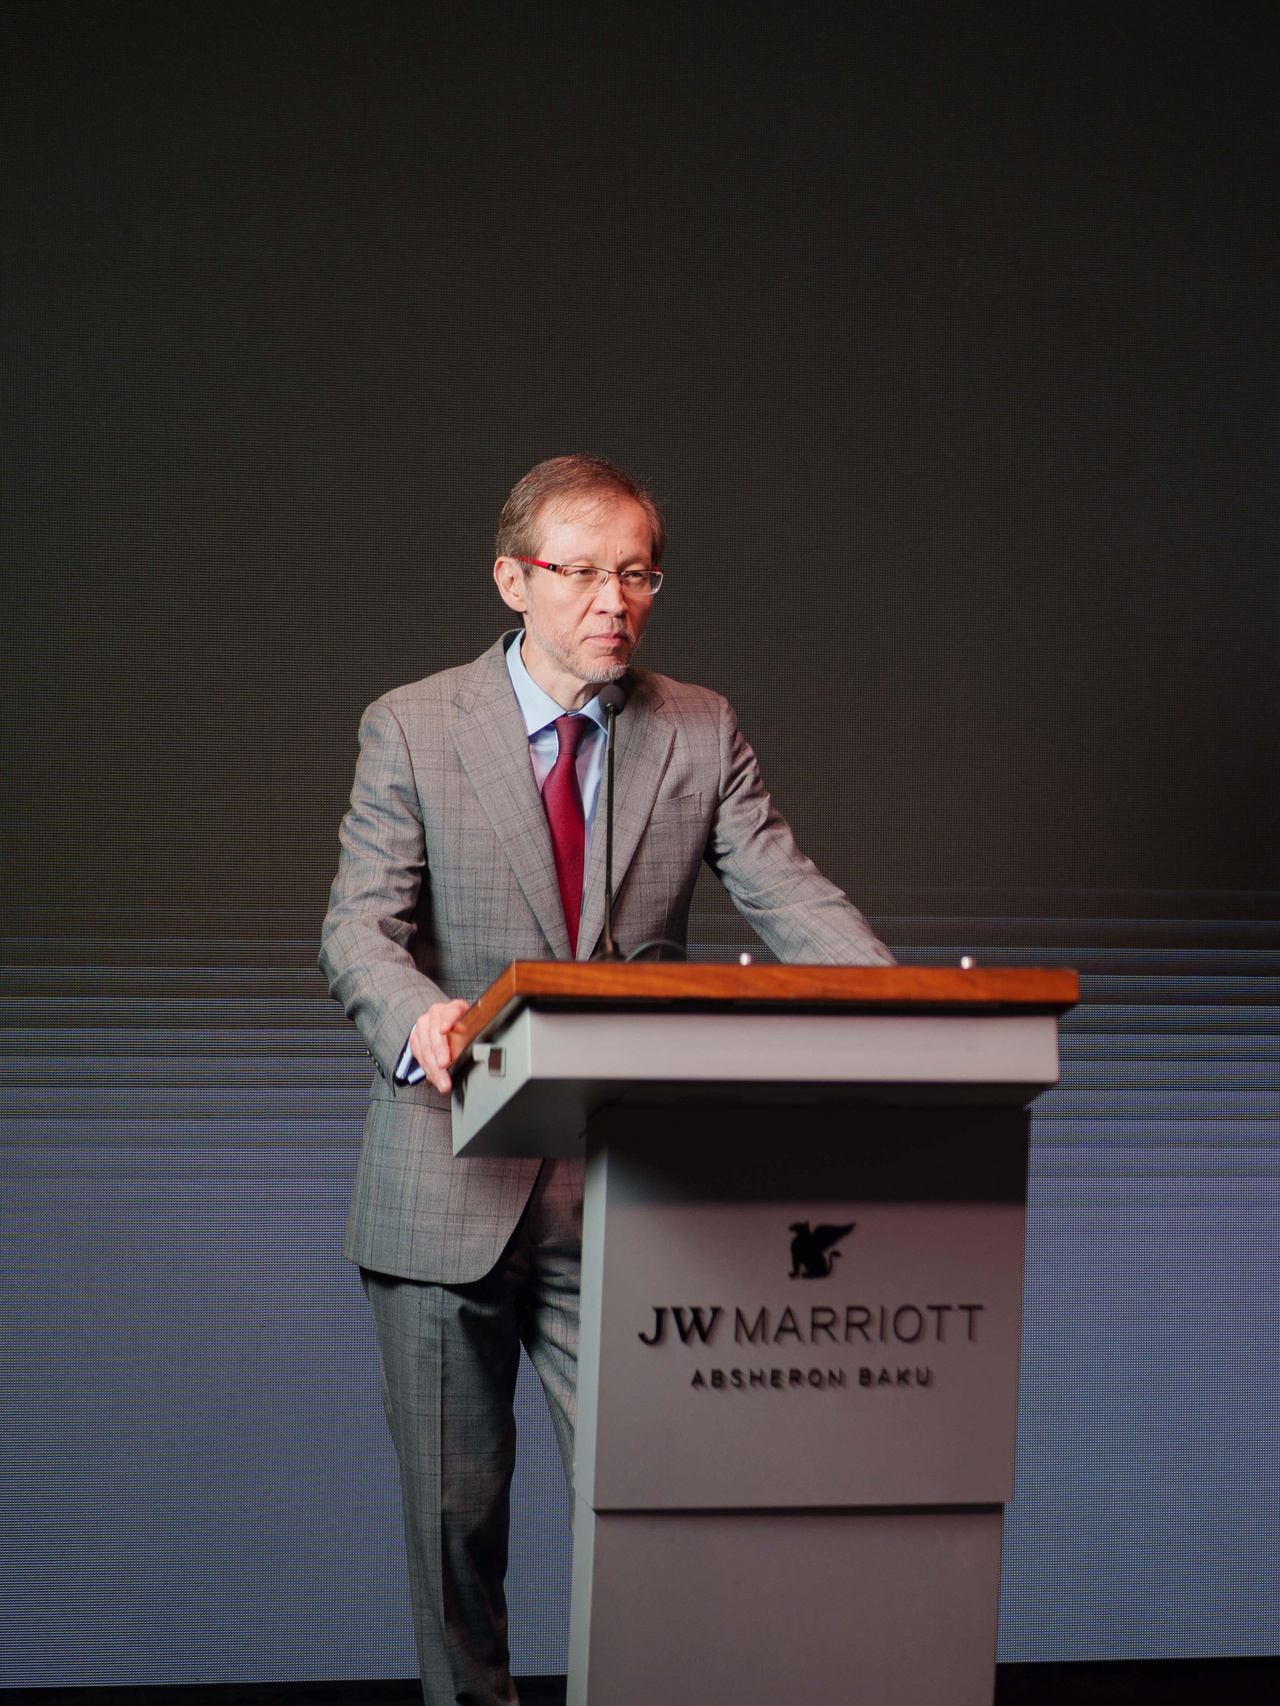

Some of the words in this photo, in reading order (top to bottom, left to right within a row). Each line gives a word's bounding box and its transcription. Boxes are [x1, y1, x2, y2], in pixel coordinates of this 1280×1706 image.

[638, 1305, 724, 1346] JW
[734, 1303, 985, 1344] MARRIOTT
[690, 1366, 845, 1389] ABSHERON
[858, 1366, 934, 1388] BAKU
